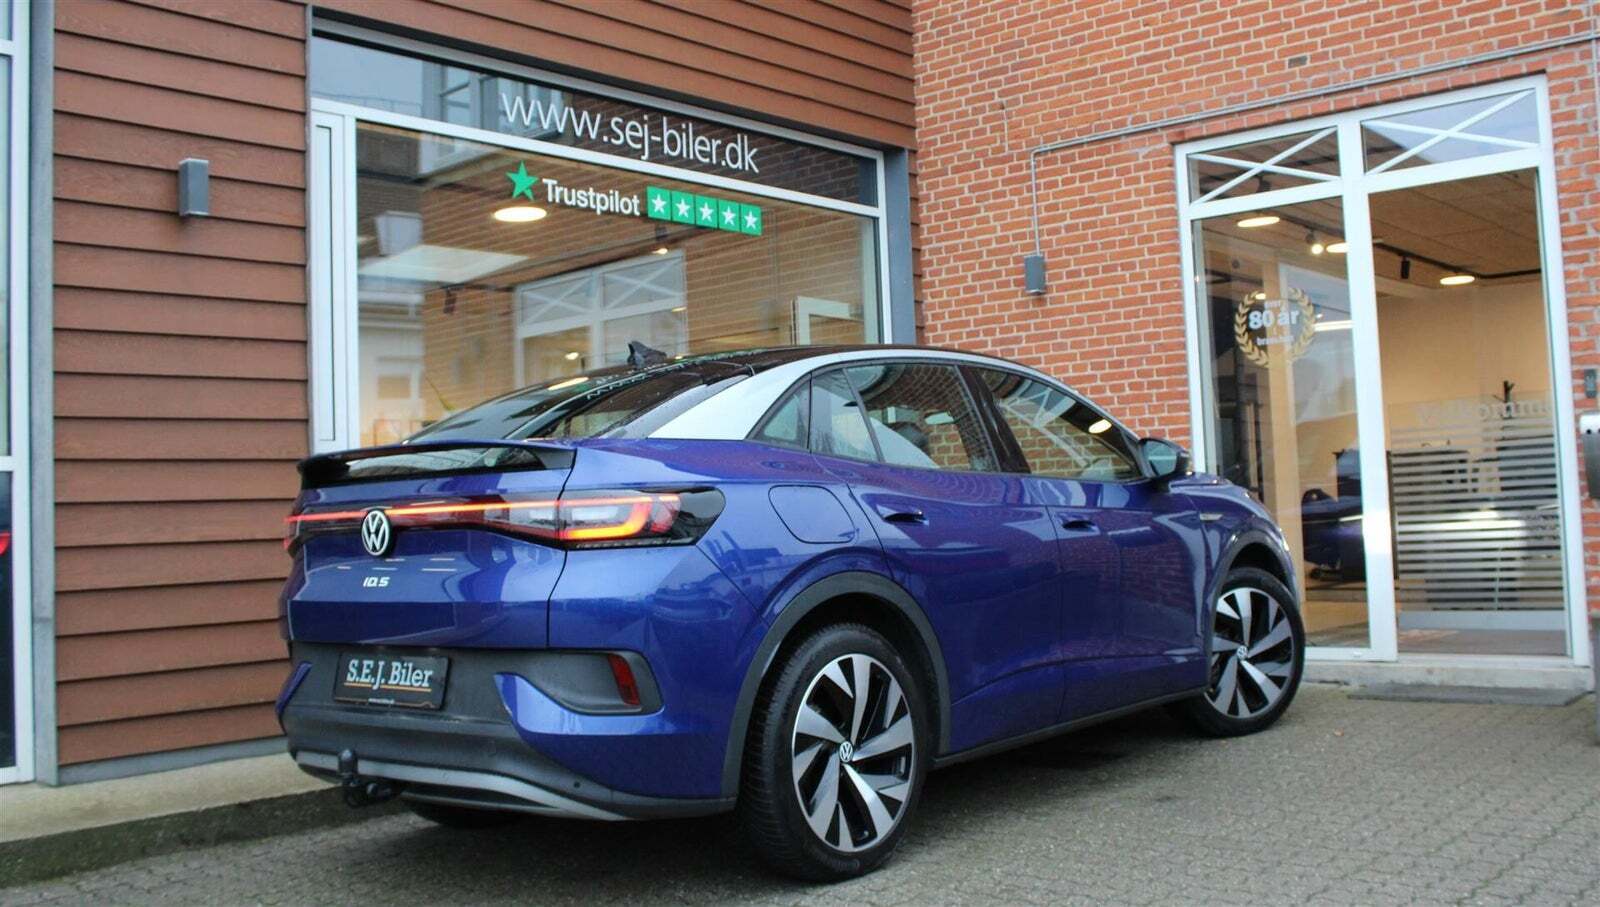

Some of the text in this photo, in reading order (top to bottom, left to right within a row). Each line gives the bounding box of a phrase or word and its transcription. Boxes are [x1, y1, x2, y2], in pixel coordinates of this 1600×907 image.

[502, 93, 759, 173] www.sej-biler.dk
[542, 178, 640, 216] Trustpilot
[1248, 310, 1275, 330] 80
[346, 659, 433, 690] S.E.J. Biler
